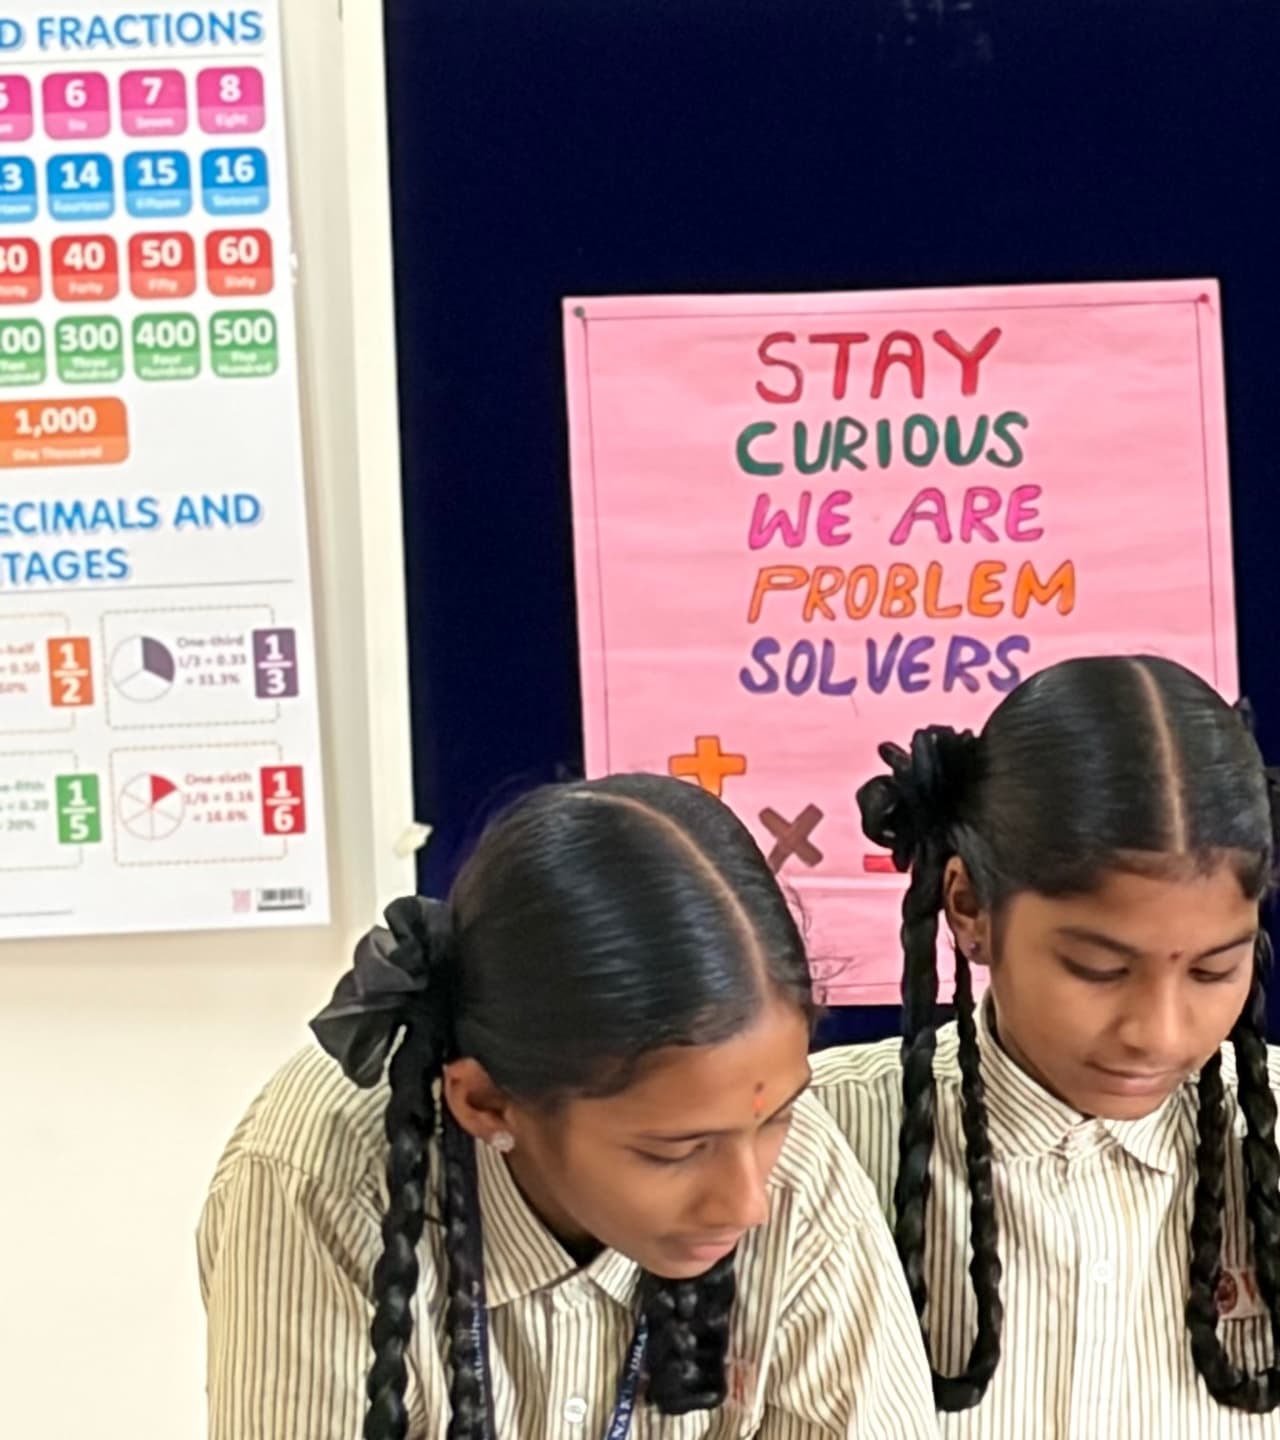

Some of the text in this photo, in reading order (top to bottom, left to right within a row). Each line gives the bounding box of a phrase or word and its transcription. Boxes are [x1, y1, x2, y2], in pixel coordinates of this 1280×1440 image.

[37, 10, 263, 48] FRACTIONS
[65, 79, 87, 108] 6
[141, 77, 163, 105] 7
[220, 74, 242, 103] 8
[0, 163, 23, 192] 3
[60, 160, 100, 189] 14
[138, 157, 178, 187] 15
[215, 154, 256, 184] 16
[63, 241, 106, 271] 40
[141, 238, 182, 268] 50
[218, 235, 260, 265] 60
[59, 322, 119, 352] 300
[136, 319, 197, 349] 400
[213, 316, 274, 347] 500
[755, 326, 1003, 404] STAY
[15, 405, 98, 440] 1,000
[735, 411, 1029, 476] CURIOUS
[173, 493, 263, 528] AND
[747, 484, 1046, 551] WE ARE
[747, 559, 1076, 624] PROBLEM
[738, 632, 1031, 697] SOLVERS
